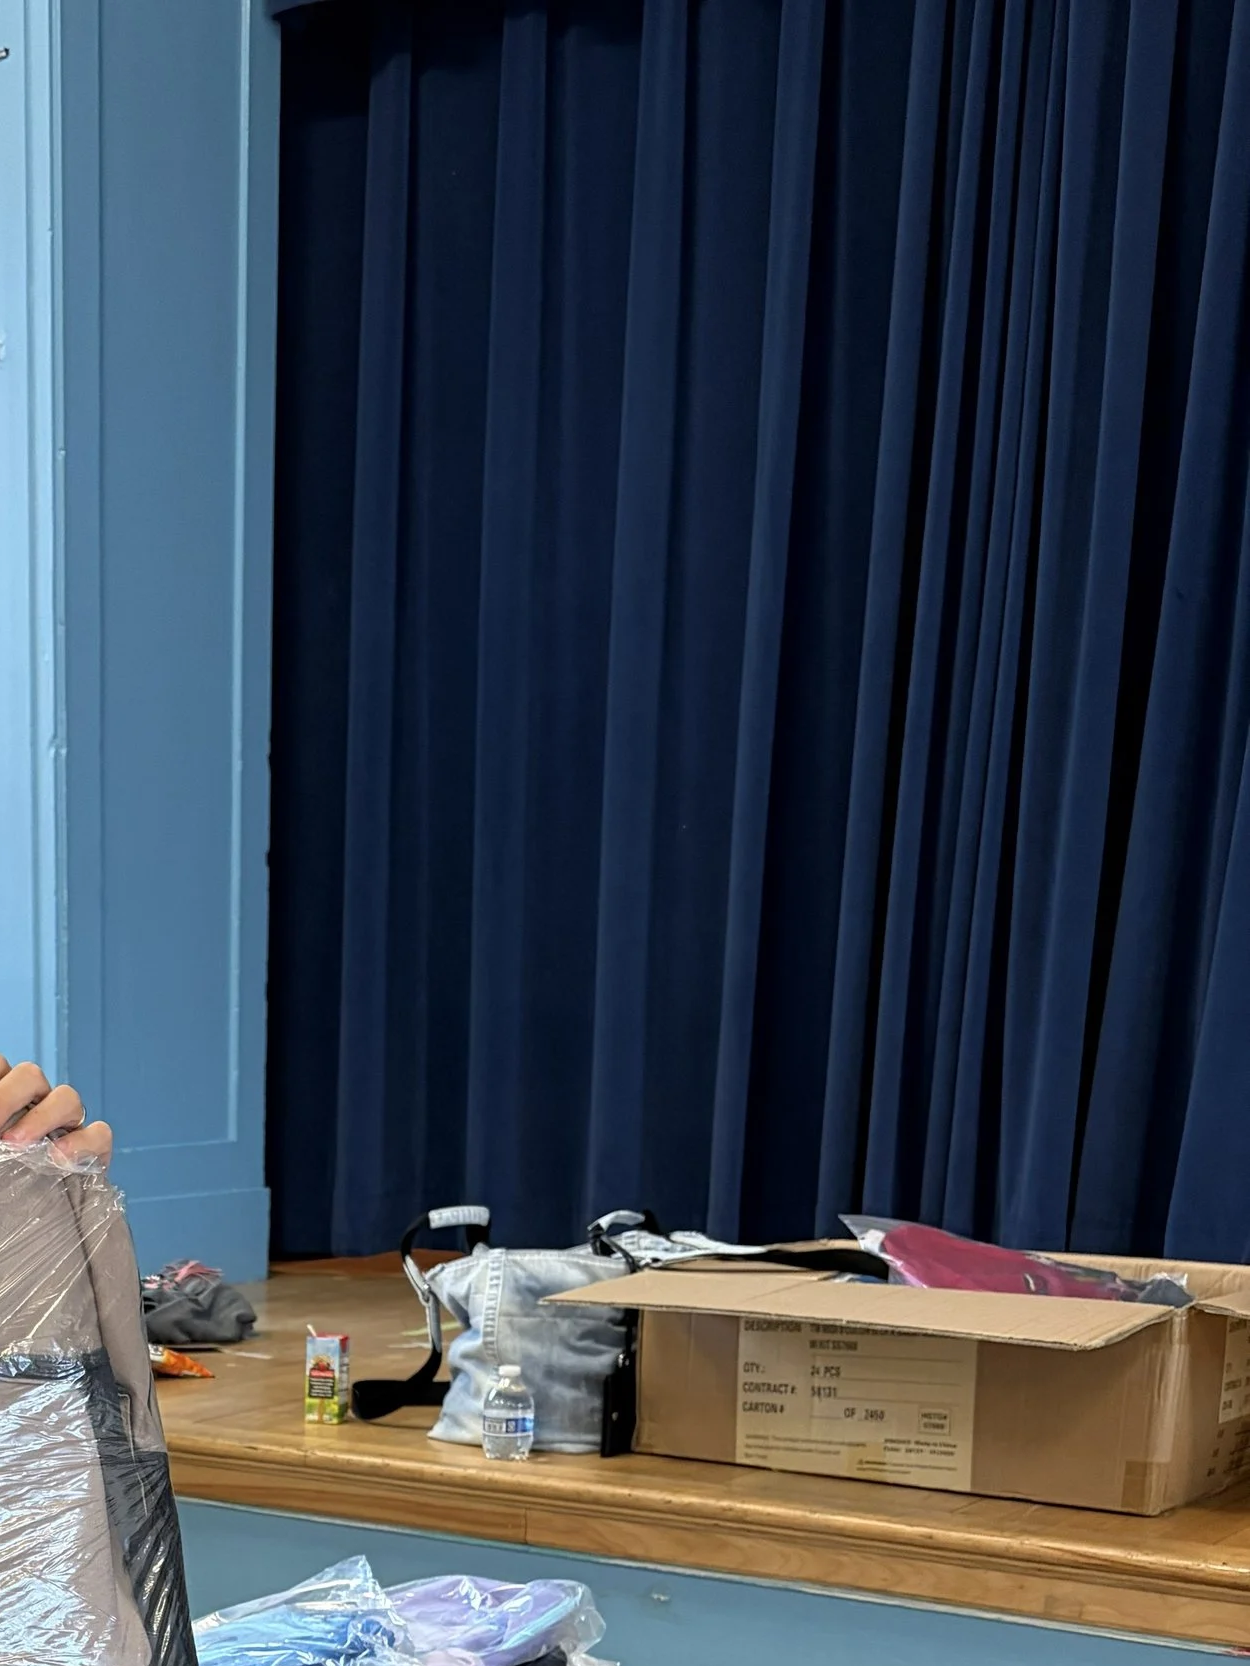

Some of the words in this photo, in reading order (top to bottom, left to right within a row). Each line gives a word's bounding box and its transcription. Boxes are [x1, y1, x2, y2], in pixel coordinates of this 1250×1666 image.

[742, 1381, 789, 1395] CONTRACT
[742, 1400, 777, 1414] CARTON
[843, 1407, 856, 1419] OF
